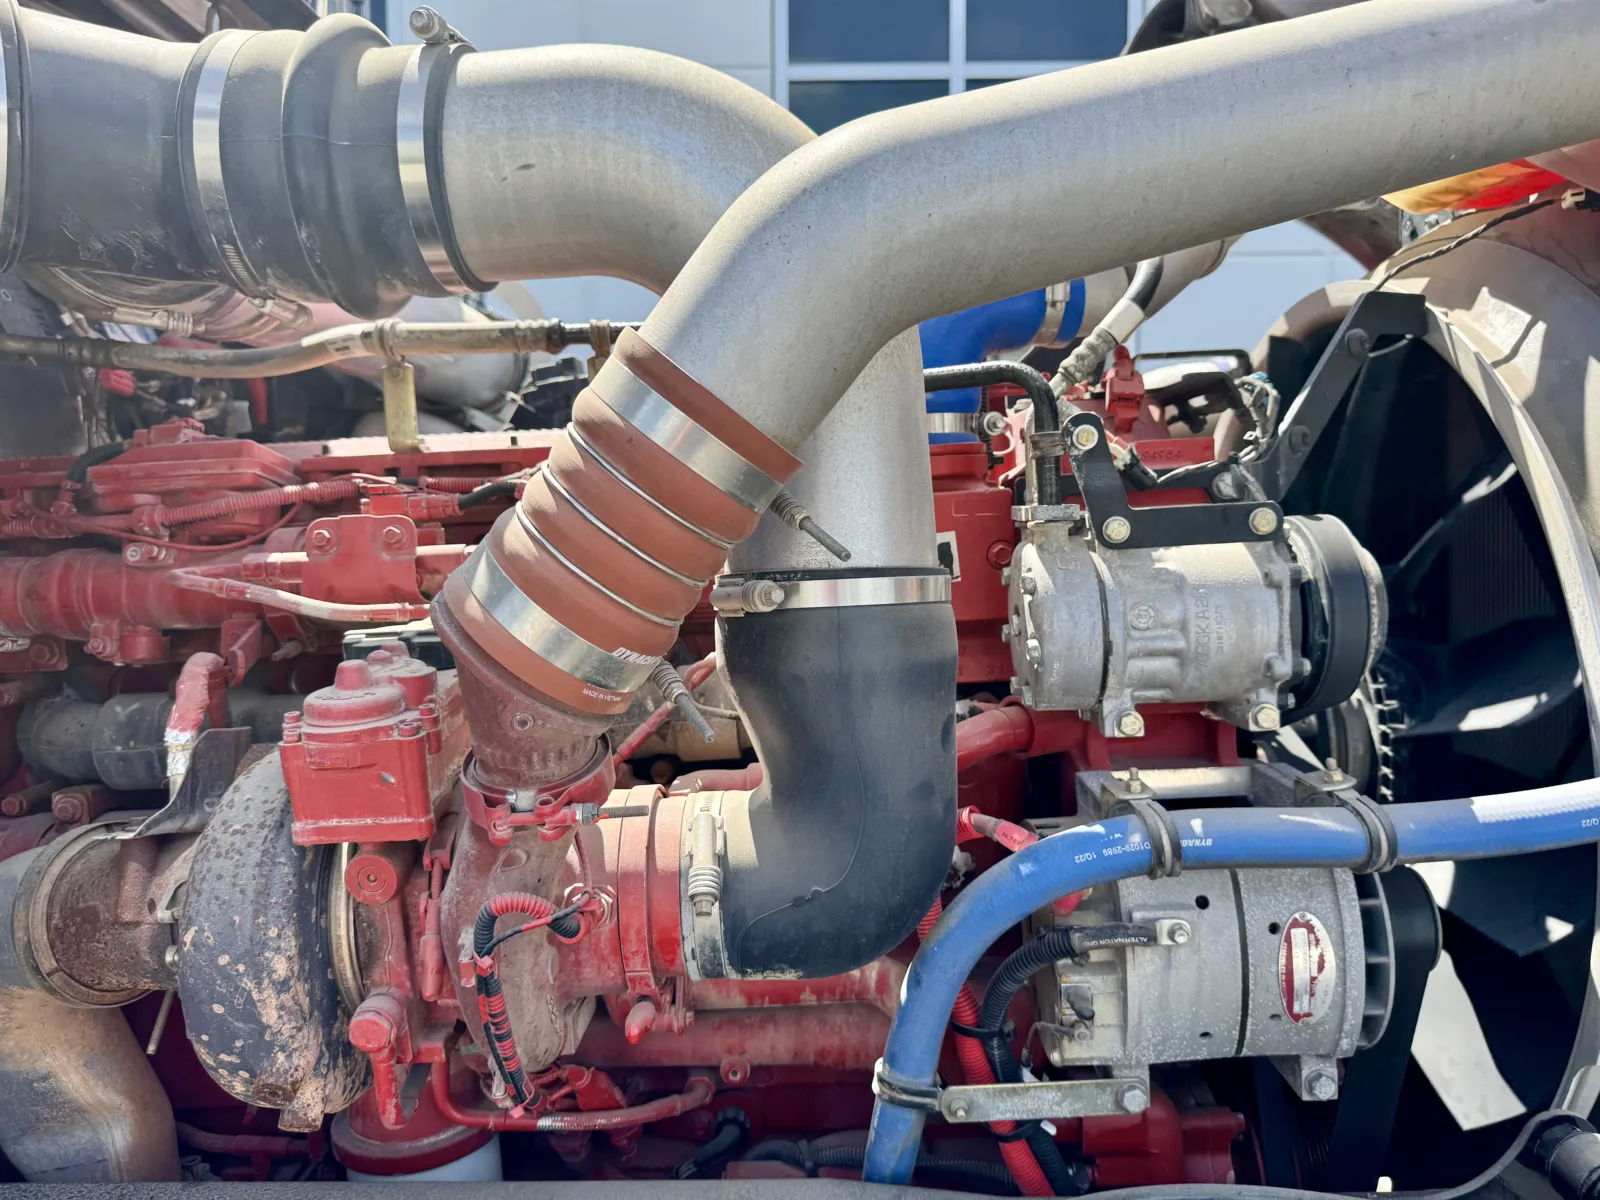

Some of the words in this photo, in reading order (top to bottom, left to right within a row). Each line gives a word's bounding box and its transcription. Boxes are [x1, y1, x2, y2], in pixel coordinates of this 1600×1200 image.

[582, 687, 598, 698] MADE
[598, 692, 605, 700] IN
[1580, 817, 1600, 828] Q/22
[1102, 841, 1151, 857] D1029-2989
[1073, 851, 1097, 864] 1Q/22
[1082, 940, 1099, 948] GND
[1099, 936, 1149, 946] ALTERNATOR
